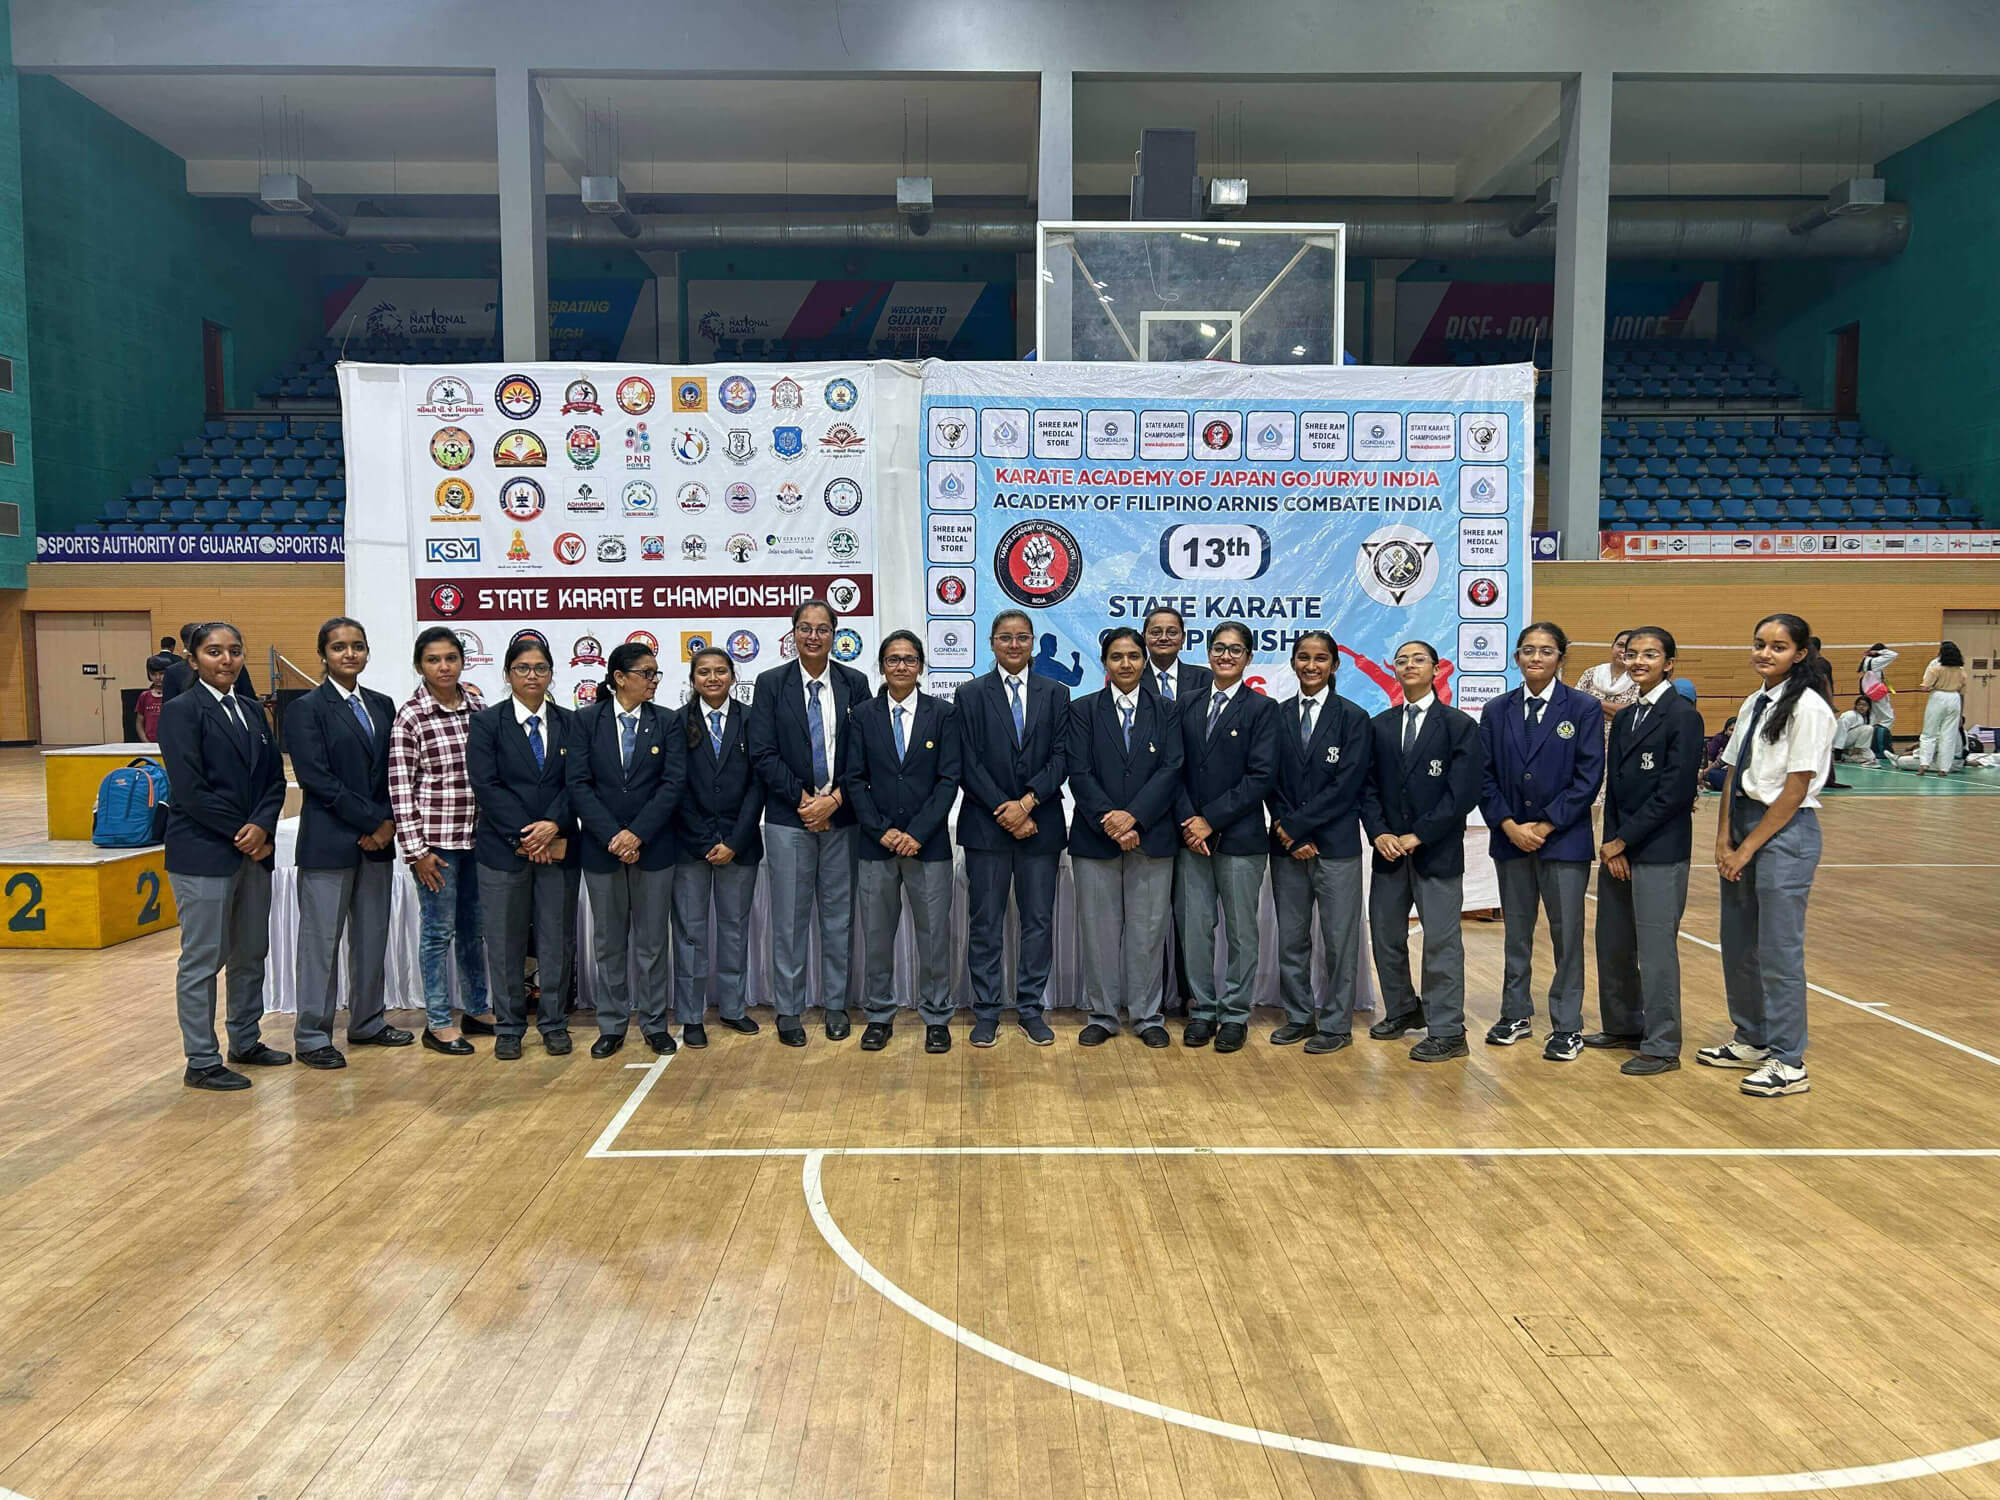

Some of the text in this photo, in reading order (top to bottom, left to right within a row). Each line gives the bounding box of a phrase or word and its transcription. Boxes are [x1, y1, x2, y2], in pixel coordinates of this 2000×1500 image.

[410, 308, 466, 324] NATIONAL
[892, 306, 947, 314] WELCOME TO
[410, 325, 448, 334] GAMES
[729, 316, 769, 328] NATIONAL
[888, 315, 945, 326] GUJARAT
[729, 327, 756, 335] GAMES
[626, 455, 650, 463] PNR
[996, 468, 1440, 486] KARATE ACADEMY OF JAPAN GOJURYU INDIA
[994, 494, 1442, 512] ACADEMY OF FILIPINO ARNIS COMBATE INDIA
[48, 536, 259, 554] SPORTS AUTHORITY OF GUJARAT
[276, 536, 327, 554] SPORTS
[431, 543, 476, 558] KSM
[1000, 537, 1013, 559] KARATE
[1012, 525, 1035, 539] ACADEMY
[1045, 526, 1061, 537] JAPAN
[1183, 536, 1250, 568] 13th
[478, 584, 814, 610] STATE KARATE CHAMPIONSHIP
[1109, 596, 1321, 618] STATE KARATE
[5, 872, 46, 932] 2
[137, 872, 160, 925] 2
